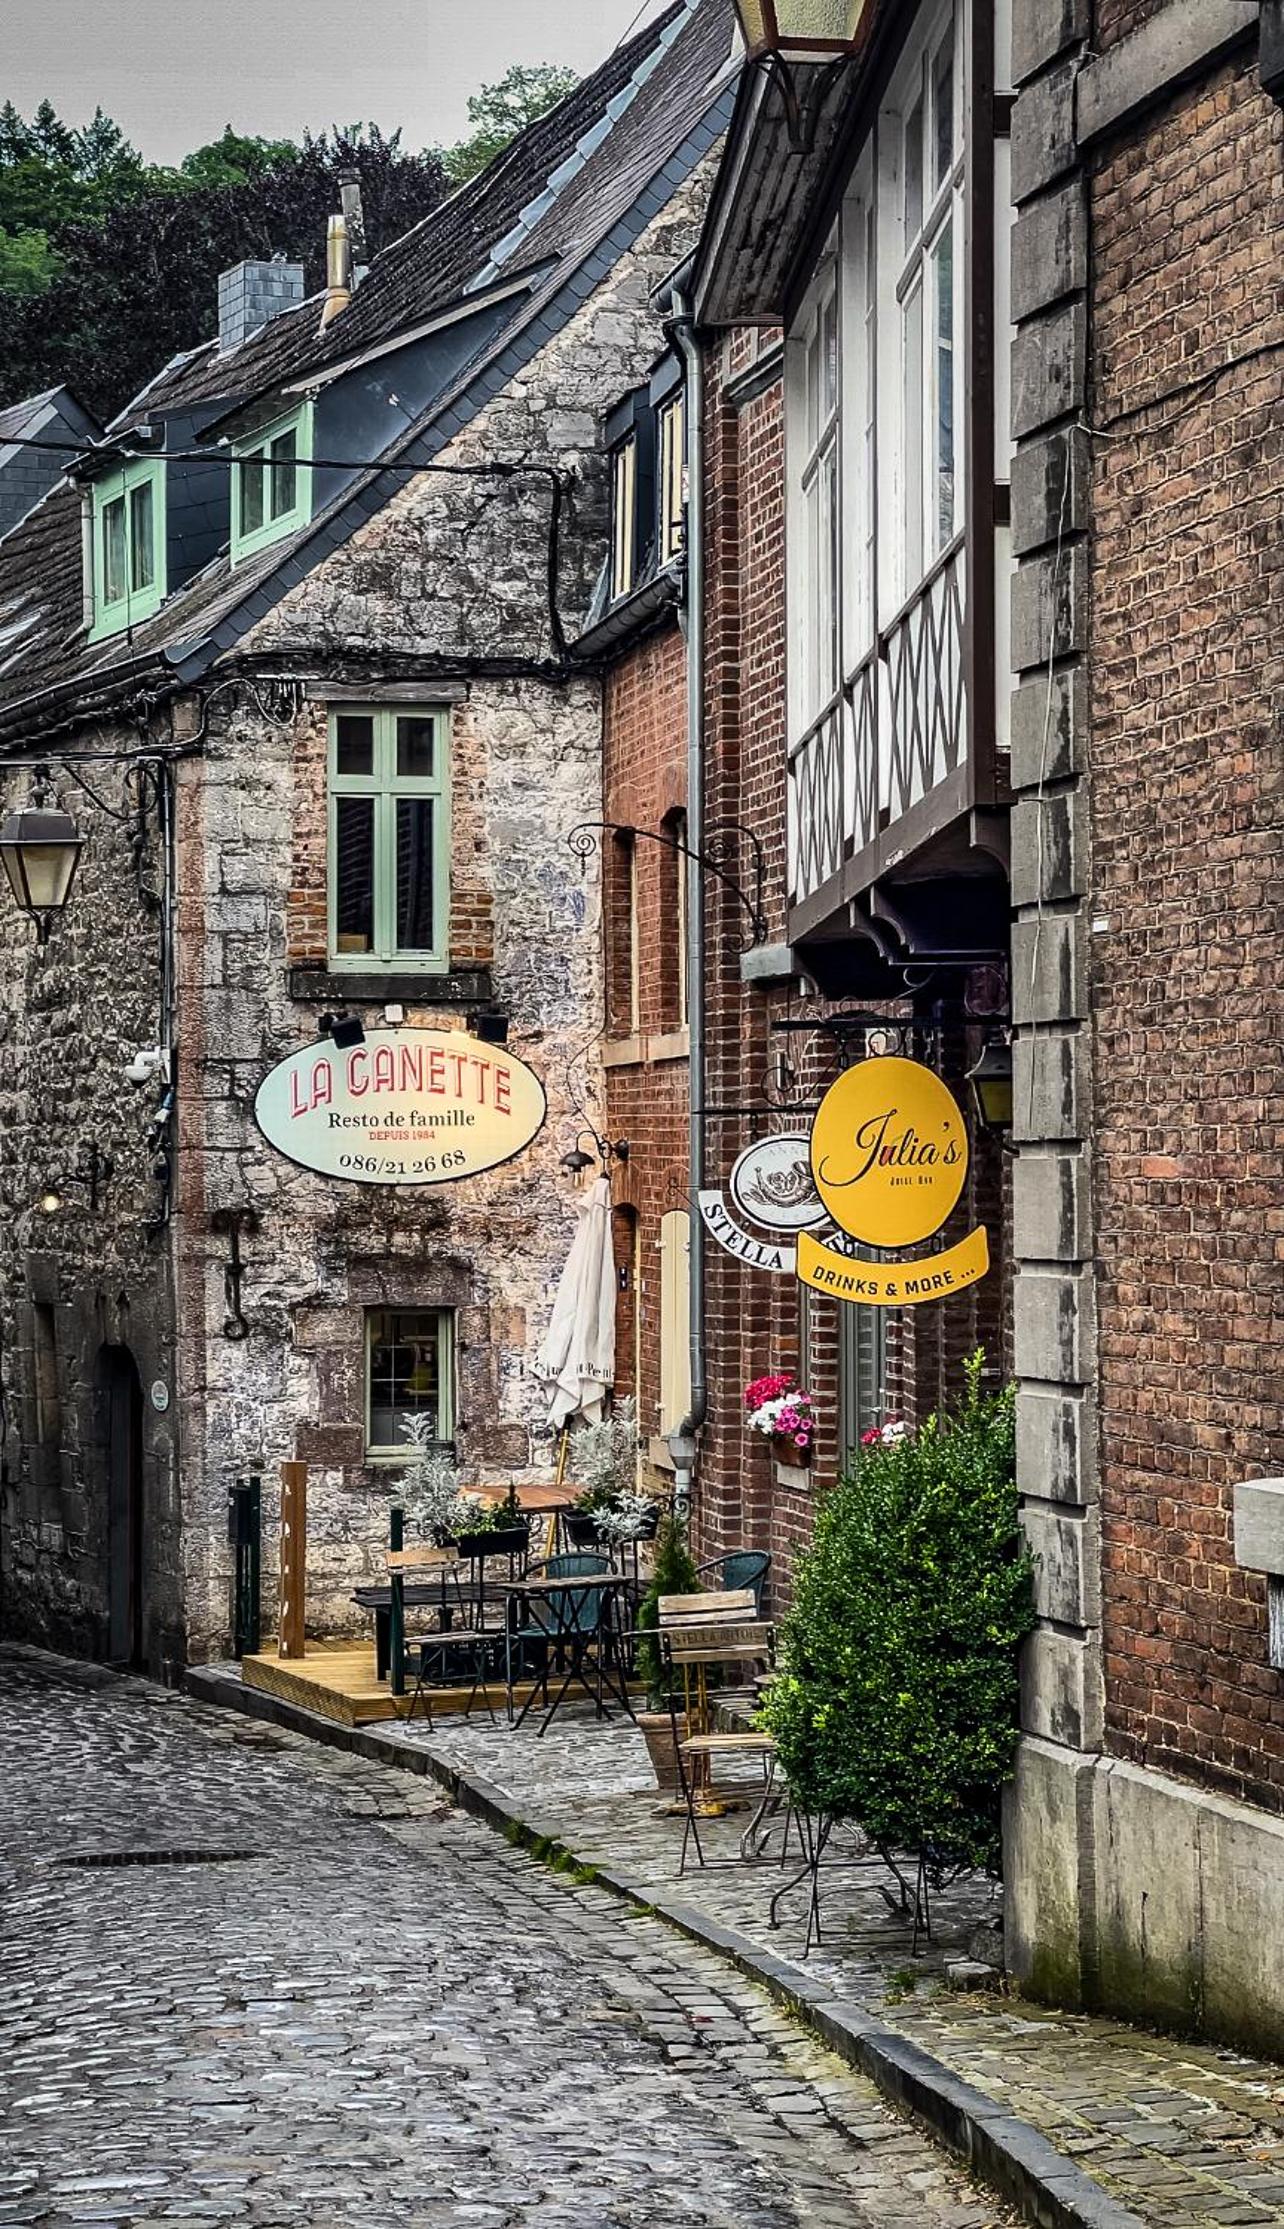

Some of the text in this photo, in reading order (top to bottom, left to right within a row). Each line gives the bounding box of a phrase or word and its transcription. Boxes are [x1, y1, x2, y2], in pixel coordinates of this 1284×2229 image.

[290, 1044, 512, 1119] LA CANETTE
[328, 1109, 475, 1129] Resto de famille
[369, 1130, 435, 1141] DEPUIS 1984
[818, 1108, 963, 1187] Julia's
[339, 1149, 466, 1175] 086/21 26 68
[703, 1202, 784, 1270] STELLA
[812, 1265, 878, 1295] DRINKS
[885, 1282, 898, 1297] &
[905, 1270, 955, 1296] MORE
